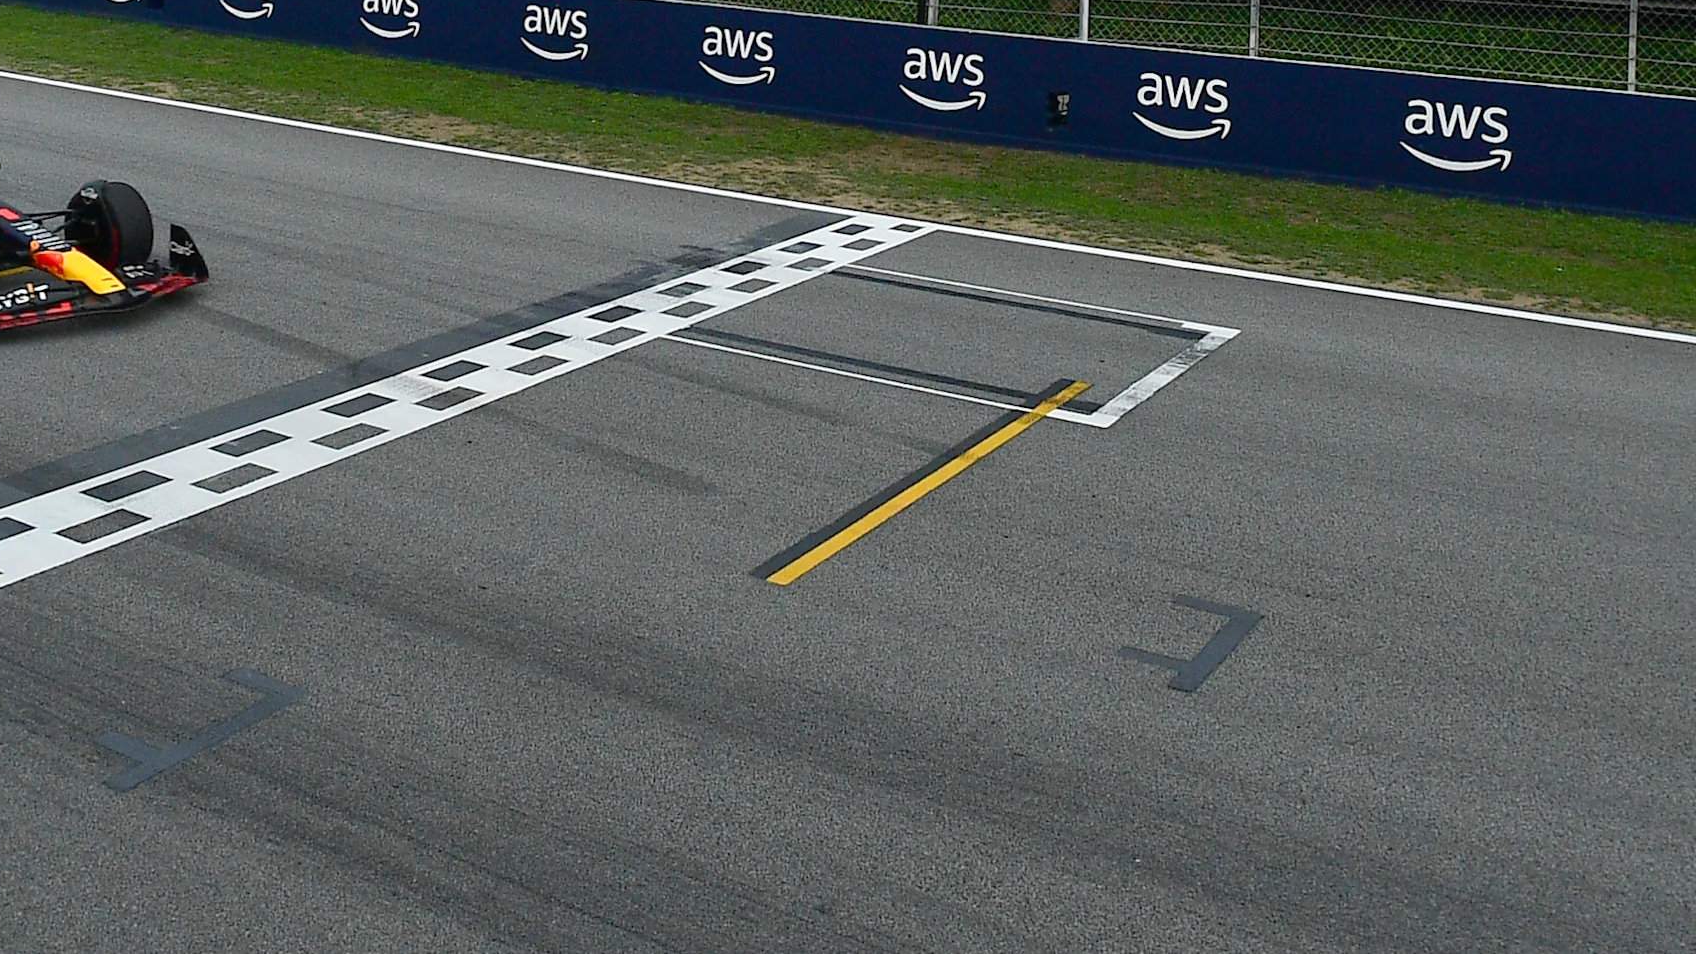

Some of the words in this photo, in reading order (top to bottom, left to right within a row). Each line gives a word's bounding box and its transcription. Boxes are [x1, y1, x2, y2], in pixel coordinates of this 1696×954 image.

[523, 5, 588, 39] aws
[702, 26, 774, 62] aws
[904, 48, 986, 88] aws
[1136, 72, 1230, 114] aws
[1404, 99, 1510, 145] aws
